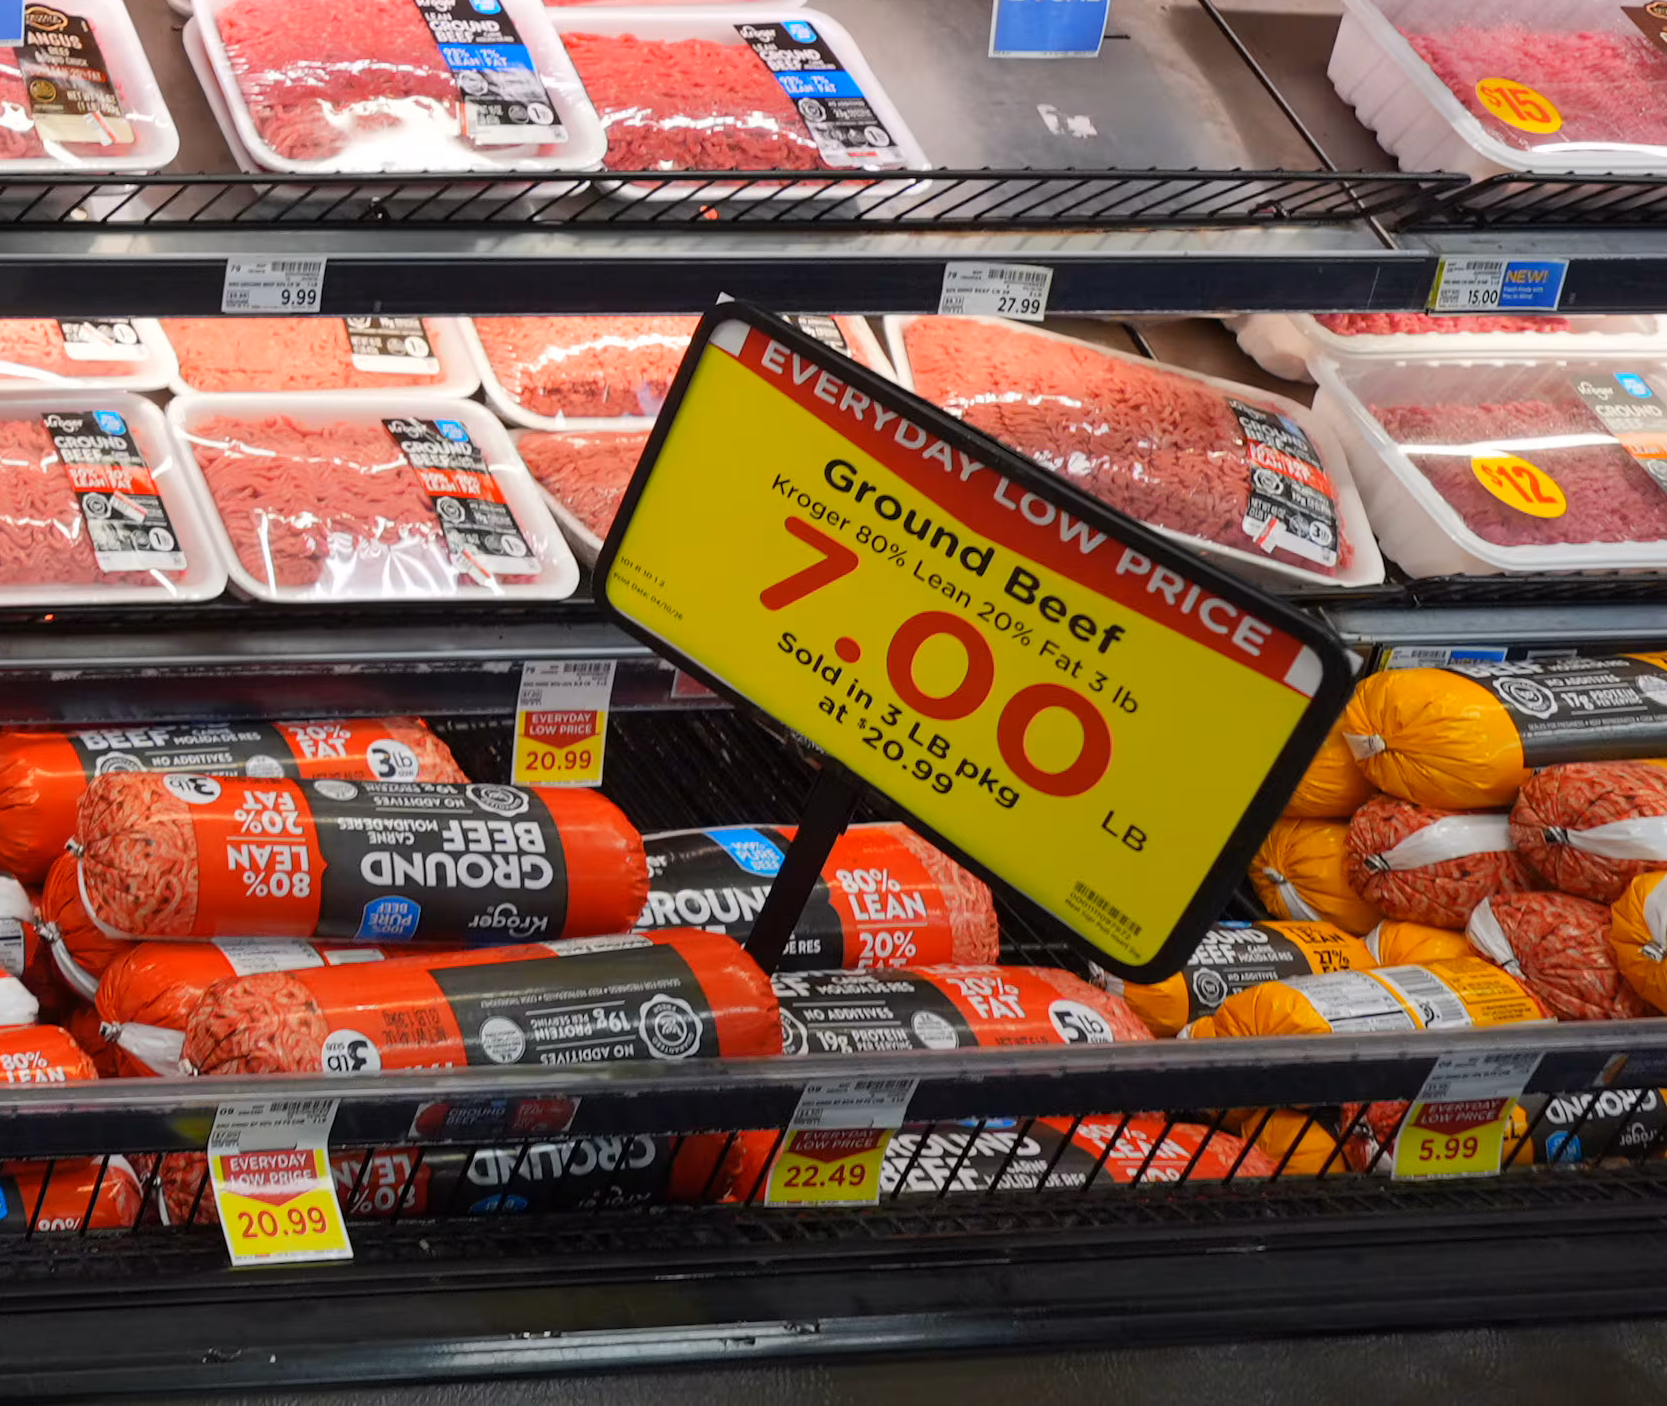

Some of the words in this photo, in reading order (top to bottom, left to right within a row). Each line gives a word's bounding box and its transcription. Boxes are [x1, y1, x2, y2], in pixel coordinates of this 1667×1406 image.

[428, 20, 500, 33] GROUND
[26, 33, 82, 50] ANGUS
[436, 31, 475, 44] BEEF
[1481, 85, 1552, 123] $15
[1505, 269, 1550, 283] NEW!
[281, 289, 317, 305] 9.99
[997, 297, 1041, 314] 27.99
[1595, 405, 1663, 418] GROUND
[55, 437, 127, 451] GROUND
[401, 439, 473, 454] GROUND
[1481, 463, 1558, 504] $12
[761, 340, 987, 483] EVERYDAY
[992, 478, 1108, 555] LOW
[1115, 548, 1273, 657] PRICE
[822, 457, 997, 576] Ground
[1003, 564, 1127, 654] Beef
[771, 473, 852, 532] Kroger
[855, 524, 906, 567] 80%
[913, 562, 972, 610] Lean
[977, 600, 1031, 647] 20%
[1038, 640, 1084, 680] Fat
[1088, 671, 1105, 694] 3
[1112, 685, 1139, 716] lb
[760, 515, 1113, 797] 7.00
[531, 712, 592, 723] EVERYDAY
[777, 631, 844, 686] Sold
[846, 677, 874, 710] in
[880, 703, 903, 726] 3
[907, 722, 951, 760] LB
[955, 757, 1021, 810] pkg
[529, 725, 557, 735] LOW
[559, 724, 592, 735] PRICE
[84, 728, 170, 751] BEEF
[818, 696, 848, 726] at
[857, 716, 955, 796] $20.99
[300, 739, 346, 759] FAT
[152, 756, 171, 766] NO
[173, 754, 233, 766] ADDITIVES
[525, 749, 592, 772] 20.99
[242, 791, 286, 810] FAT
[372, 794, 442, 808] ADDITIVES
[445, 797, 465, 808] NO
[234, 810, 305, 835] 20%
[1101, 810, 1147, 852] LB
[369, 832, 415, 845] CARNE
[442, 820, 546, 852] BEEF
[228, 844, 310, 870] LEAN
[360, 851, 554, 890] GROUND
[246, 871, 311, 897] 80%
[835, 868, 901, 894] 80%
[848, 891, 928, 922] LEAN
[367, 913, 413, 925] PURE
[468, 903, 548, 938] Kroger
[858, 930, 917, 959] 20%
[1313, 950, 1350, 968] 27%
[803, 1008, 824, 1021] NO
[827, 1006, 894, 1021] ADDITIVES
[967, 994, 1027, 1019] FAT
[534, 1025, 592, 1041] PROTEIN
[851, 1027, 907, 1043] PROTEIN
[540, 1048, 609, 1064] ADDITIVES
[613, 1043, 635, 1057] NO
[0, 1051, 47, 1069] 80%
[1428, 1100, 1500, 1114] EVERYDAY
[1420, 1112, 1454, 1125] LOW
[1455, 1109, 1496, 1123] PRICE
[795, 1140, 833, 1151] LOW
[835, 1136, 873, 1150] PRICE
[802, 1128, 875, 1141] EVERYDAY
[1418, 1136, 1479, 1161] 5.99
[230, 1153, 307, 1172] EVERYDAY
[229, 1173, 265, 1187] LOW
[269, 1170, 312, 1185] PRICE
[783, 1163, 867, 1188] 22.49
[237, 1206, 327, 1239] 20.99
